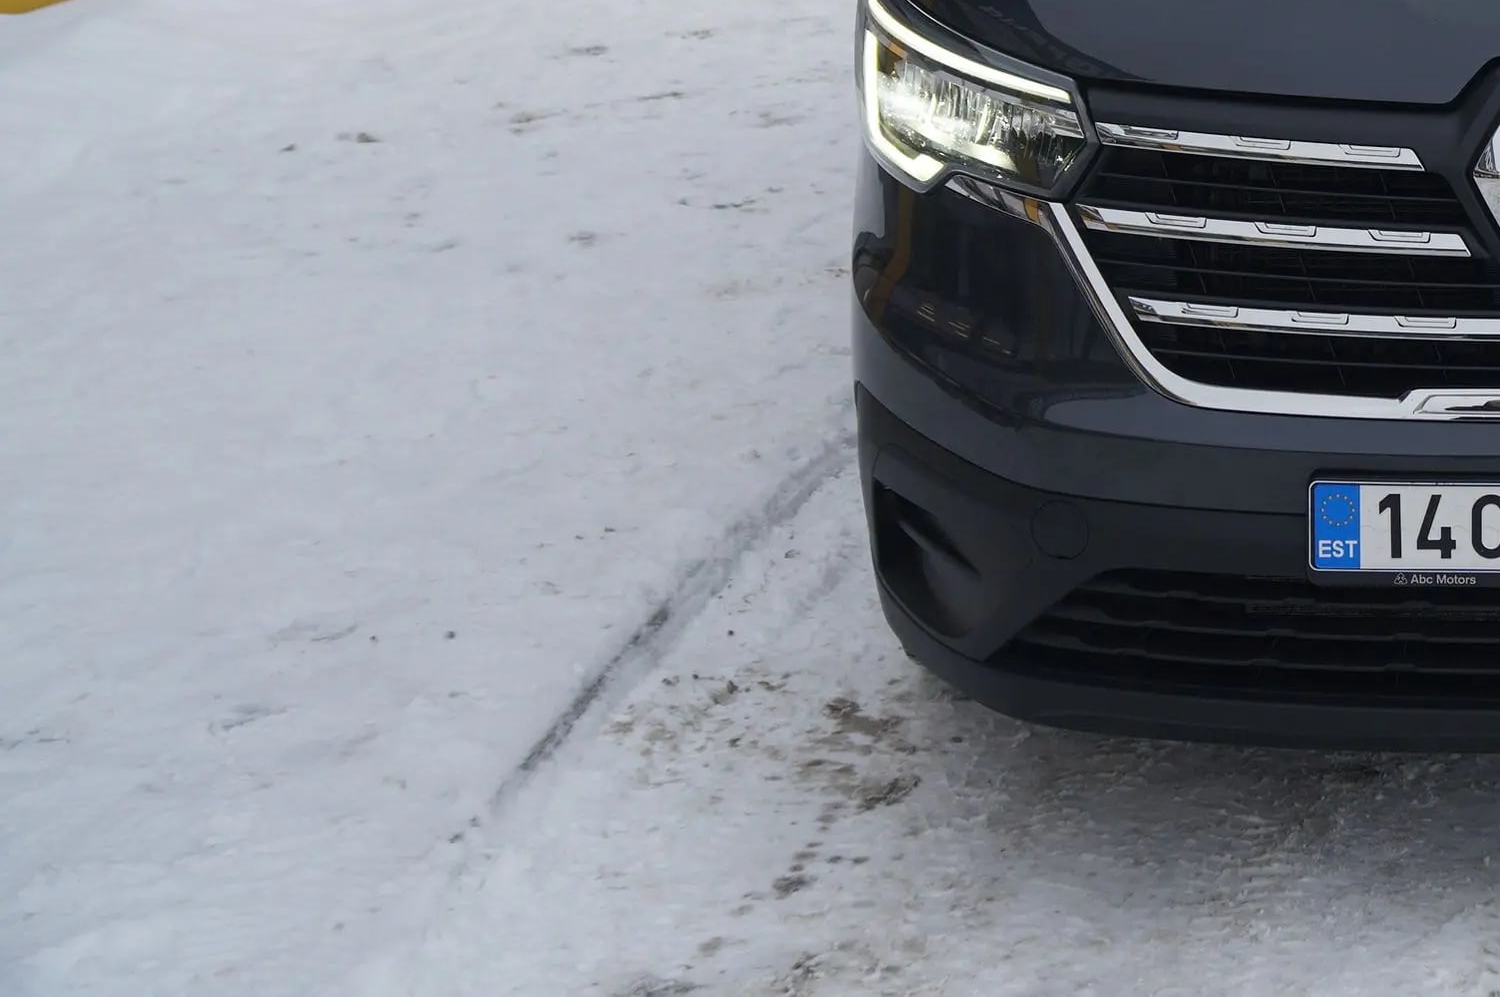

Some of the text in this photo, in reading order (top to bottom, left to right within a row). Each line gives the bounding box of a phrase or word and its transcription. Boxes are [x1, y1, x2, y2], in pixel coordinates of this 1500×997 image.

[1318, 539, 1358, 558] EST
[1410, 574, 1476, 585] Abc Motors
